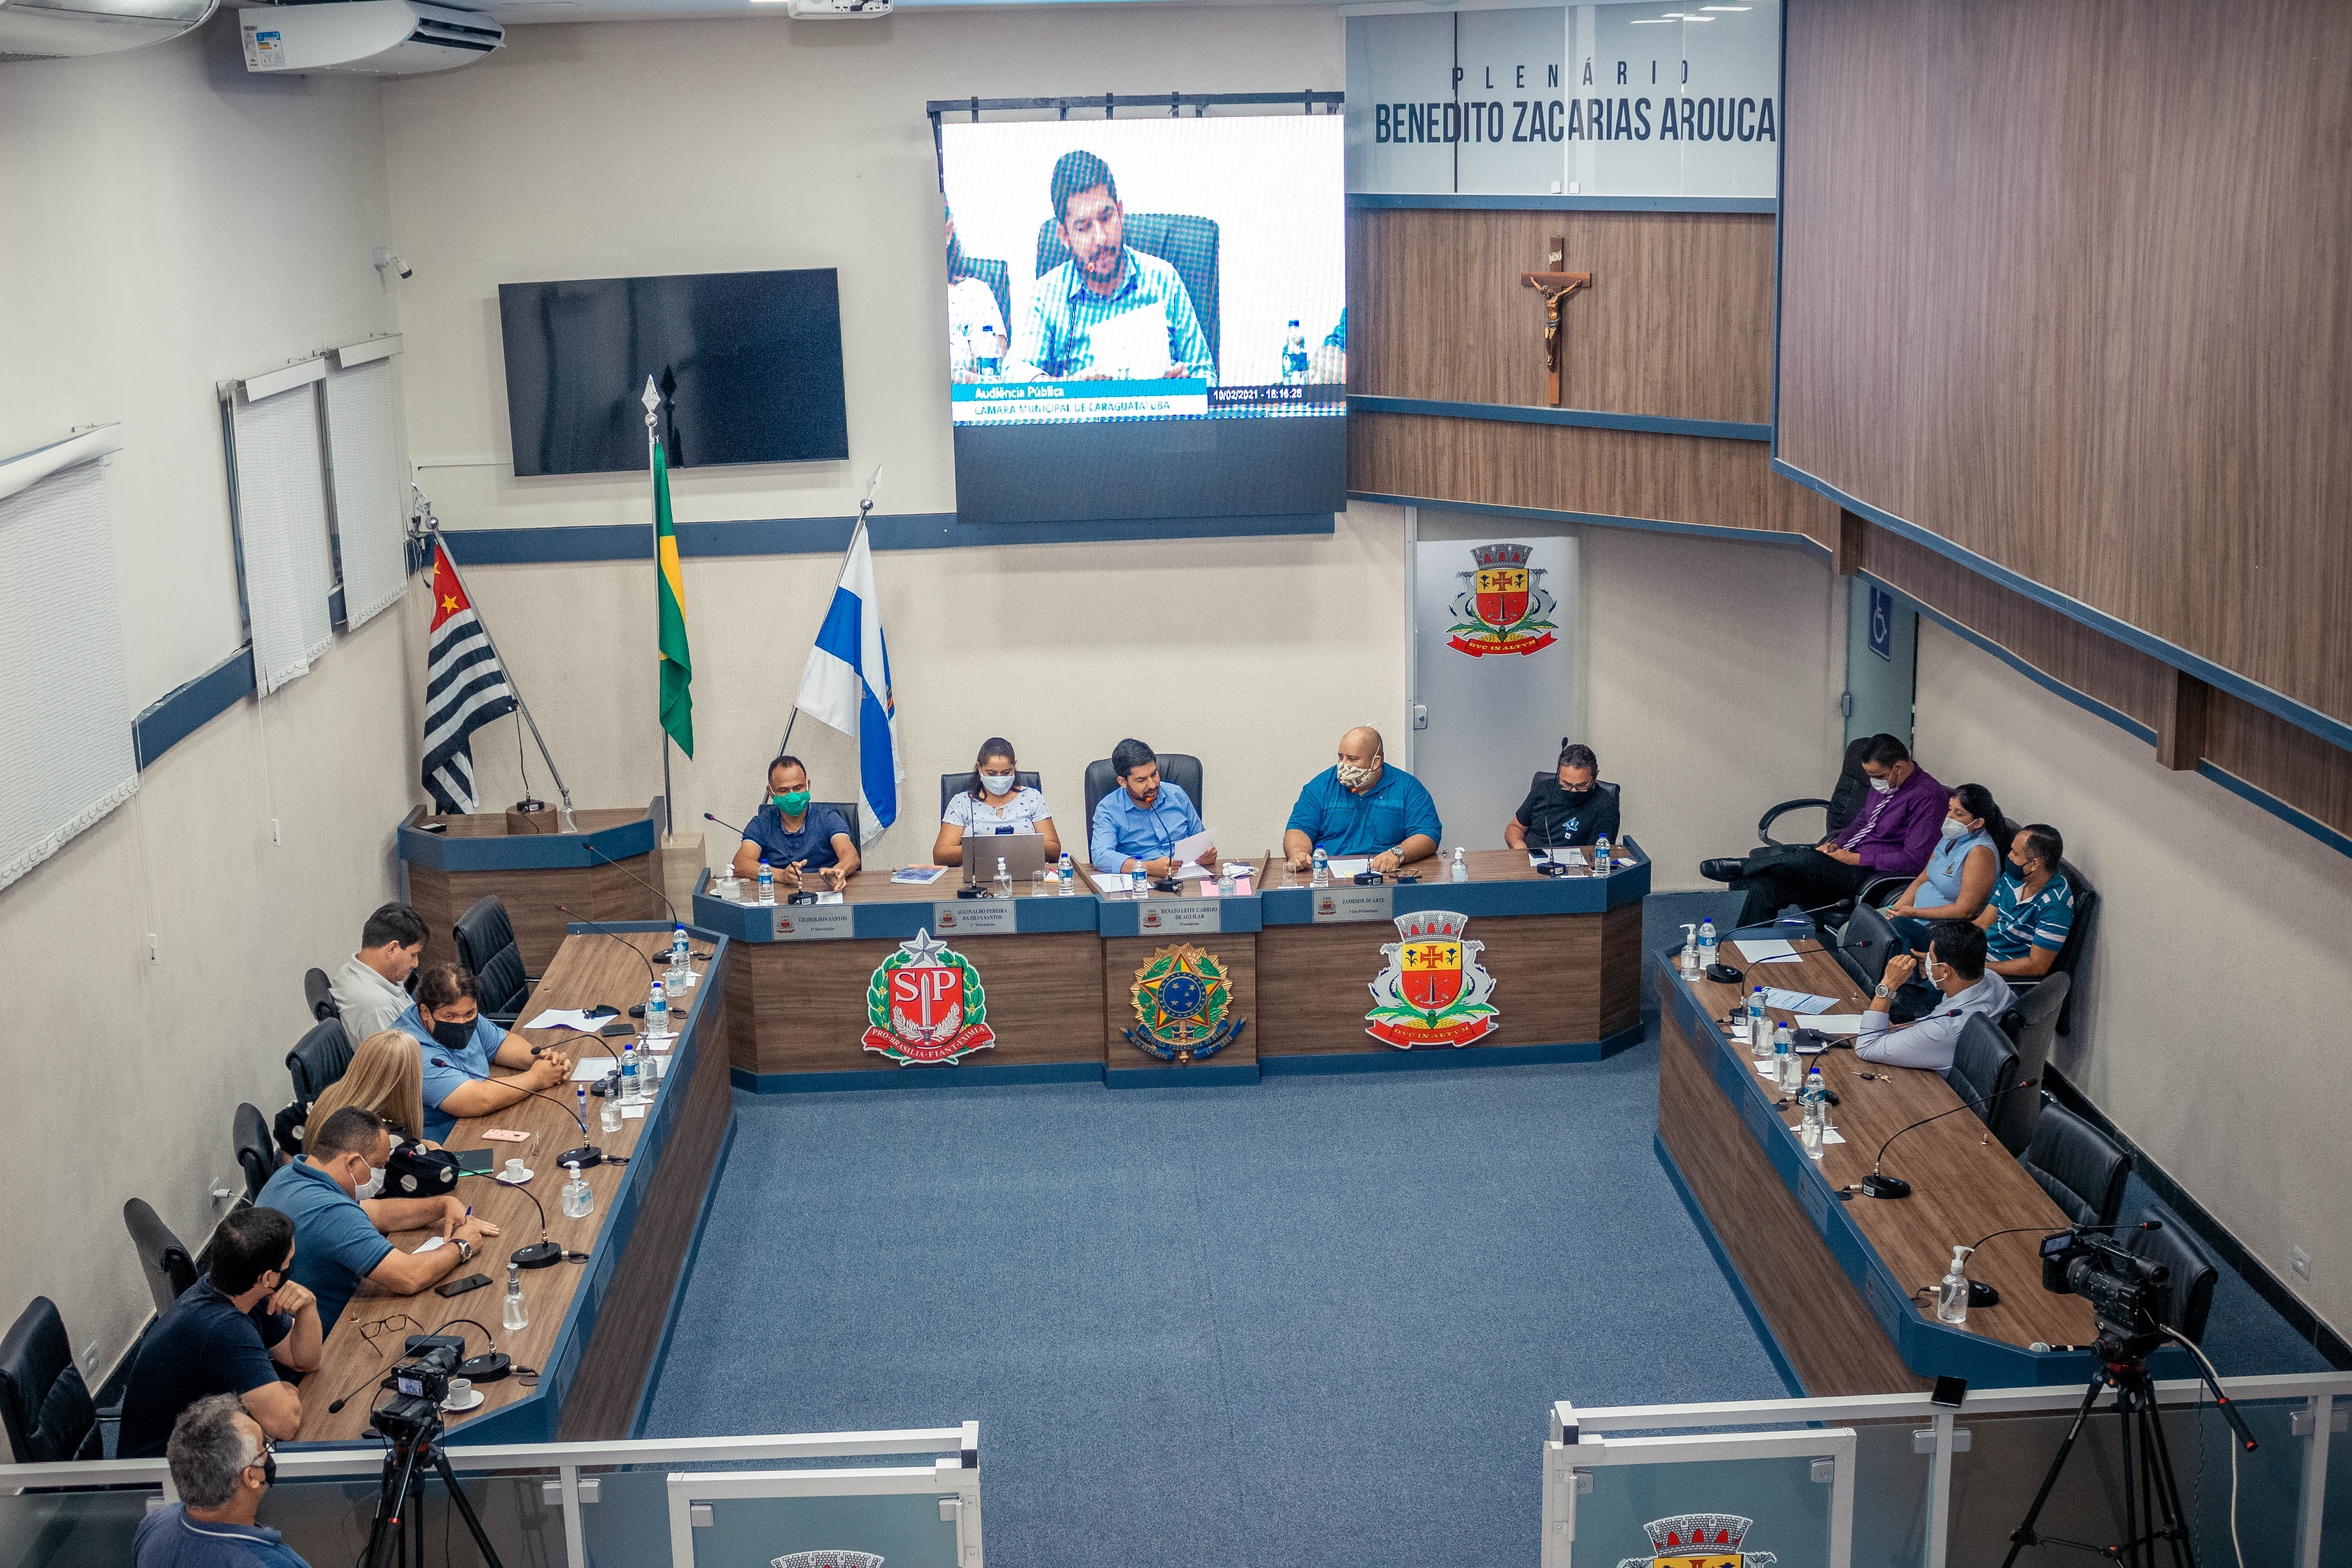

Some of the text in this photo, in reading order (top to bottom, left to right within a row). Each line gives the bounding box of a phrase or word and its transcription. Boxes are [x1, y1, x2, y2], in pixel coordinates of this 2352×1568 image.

[1452, 57, 1688, 90] PLENÁRIO
[1376, 97, 1776, 143] BENEDITO ZACARIAS AROUCA
[975, 385, 1064, 399] Audiência Pública
[1213, 388, 1258, 401] 10/02/2021
[1019, 404, 1071, 413] MUNICIPAL
[1075, 403, 1085, 412] DE
[1394, 1028, 1415, 1037] DVC
[1431, 1026, 1469, 1039] ALTVM
[872, 1029, 889, 1039] PRO
[929, 1045, 956, 1058] FIANT
